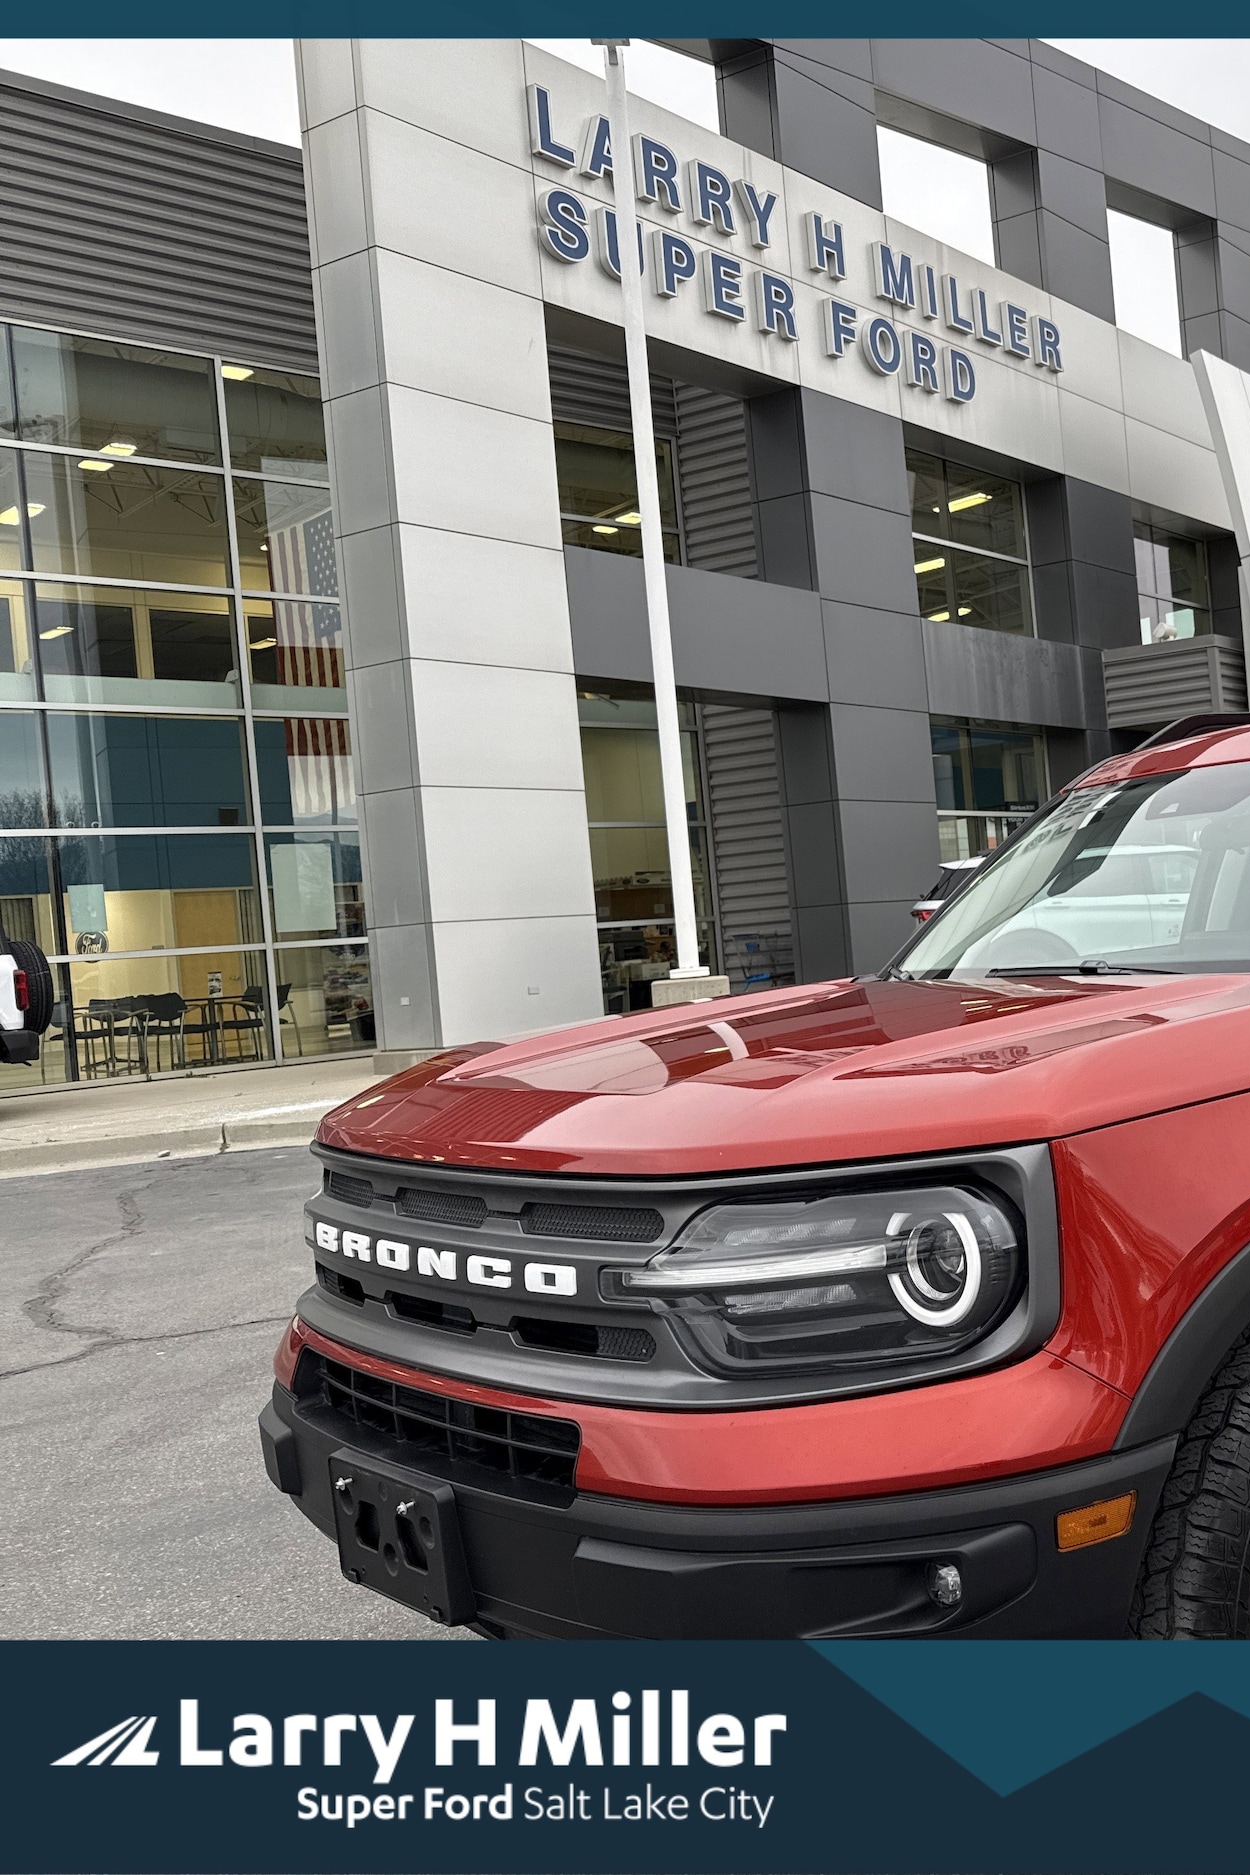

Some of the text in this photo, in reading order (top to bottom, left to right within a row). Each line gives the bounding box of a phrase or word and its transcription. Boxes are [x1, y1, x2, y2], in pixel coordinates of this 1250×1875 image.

[527, 83, 1064, 373] LARRY H MILLER
[538, 187, 977, 404] SUPER FORD
[81, 933, 103, 954] Ford
[315, 1221, 577, 1297] BRONCO
